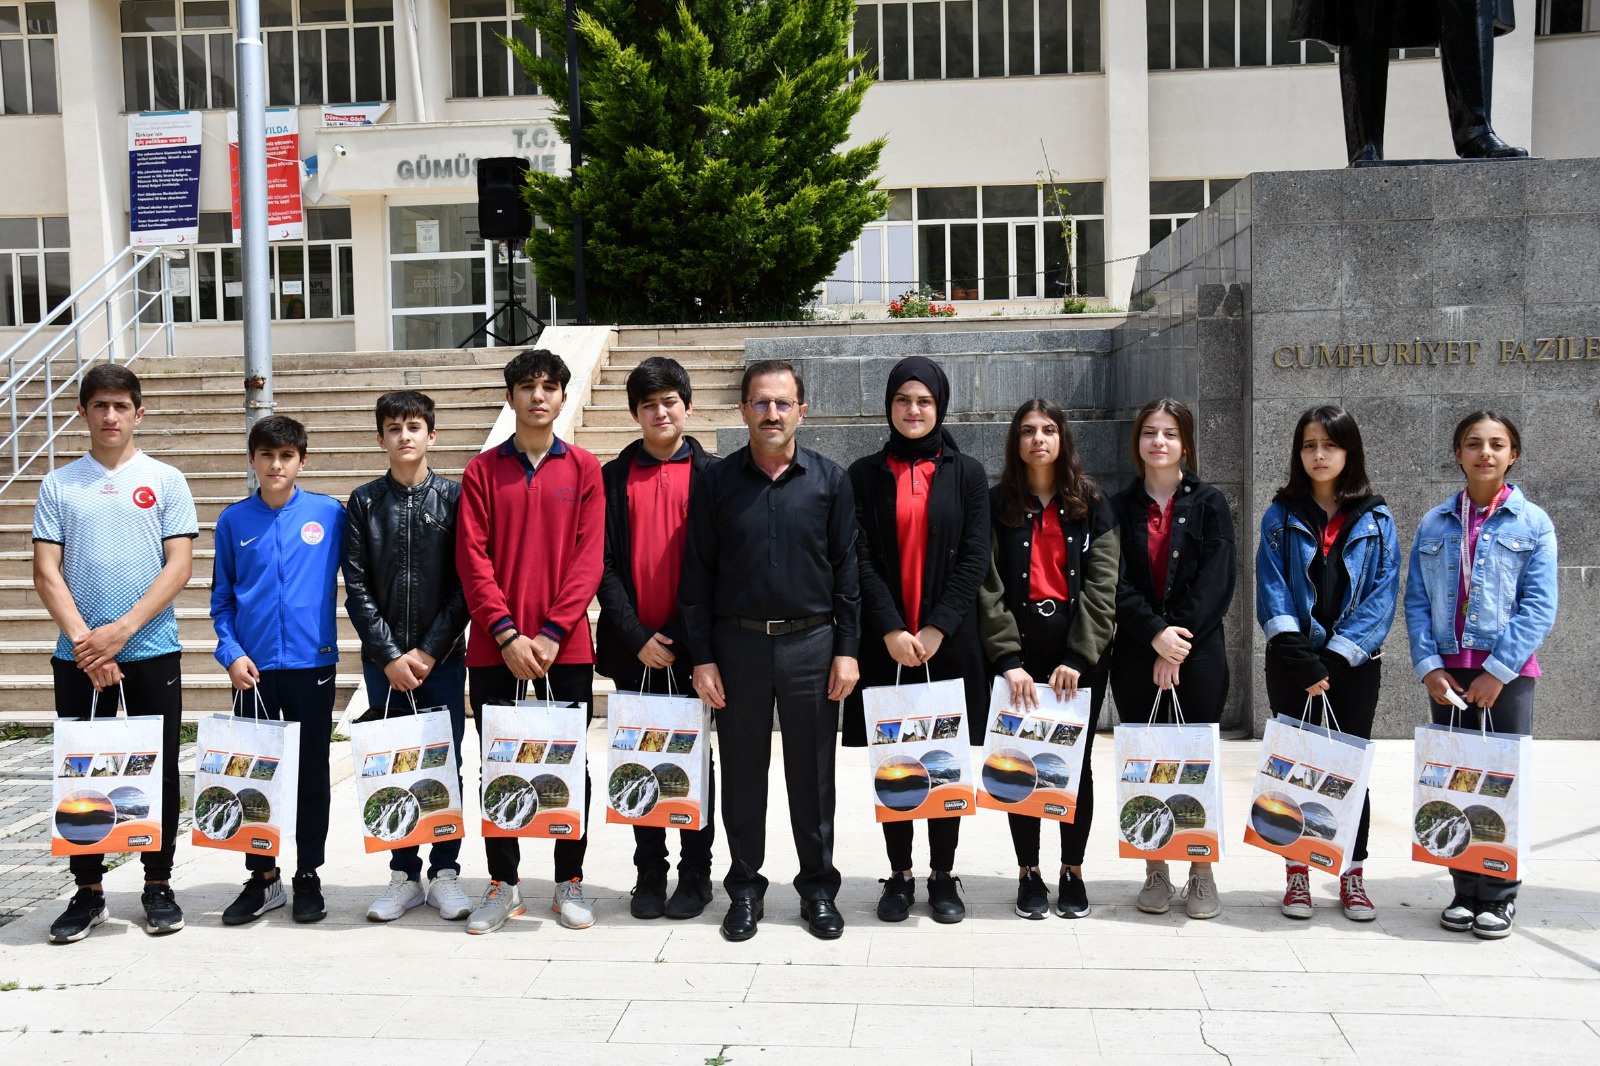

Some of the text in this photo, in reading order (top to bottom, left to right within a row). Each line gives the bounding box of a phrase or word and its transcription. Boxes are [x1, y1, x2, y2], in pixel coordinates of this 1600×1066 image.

[513, 128, 556, 148] T.C.
[397, 153, 556, 179] GÜMÜNE
[1273, 336, 1480, 368] CUMHURİYET
